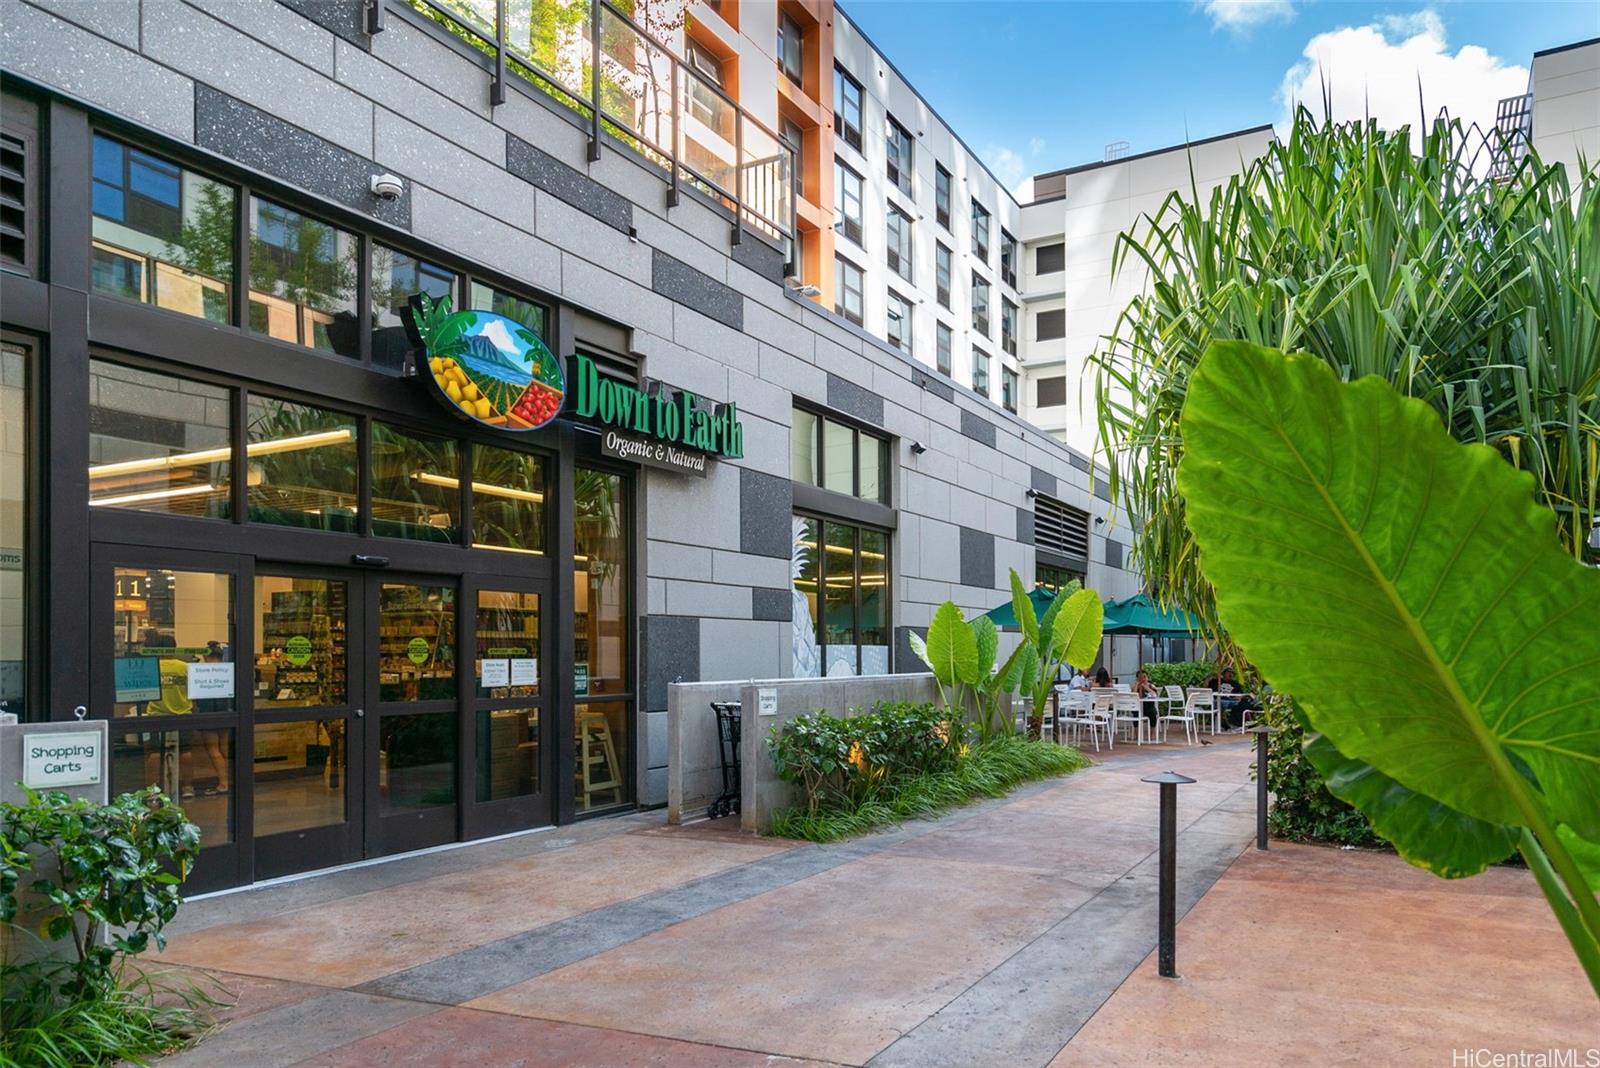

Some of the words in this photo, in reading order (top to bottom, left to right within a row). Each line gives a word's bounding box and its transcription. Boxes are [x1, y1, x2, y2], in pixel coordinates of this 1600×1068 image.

[574, 353, 652, 435] Down
[654, 380, 680, 442] to
[681, 390, 744, 459] Earth
[606, 431, 653, 458] Organic
[655, 444, 664, 461] &
[665, 446, 706, 472] Natural
[31, 745, 94, 760] Shopping
[44, 761, 82, 774] Carts
